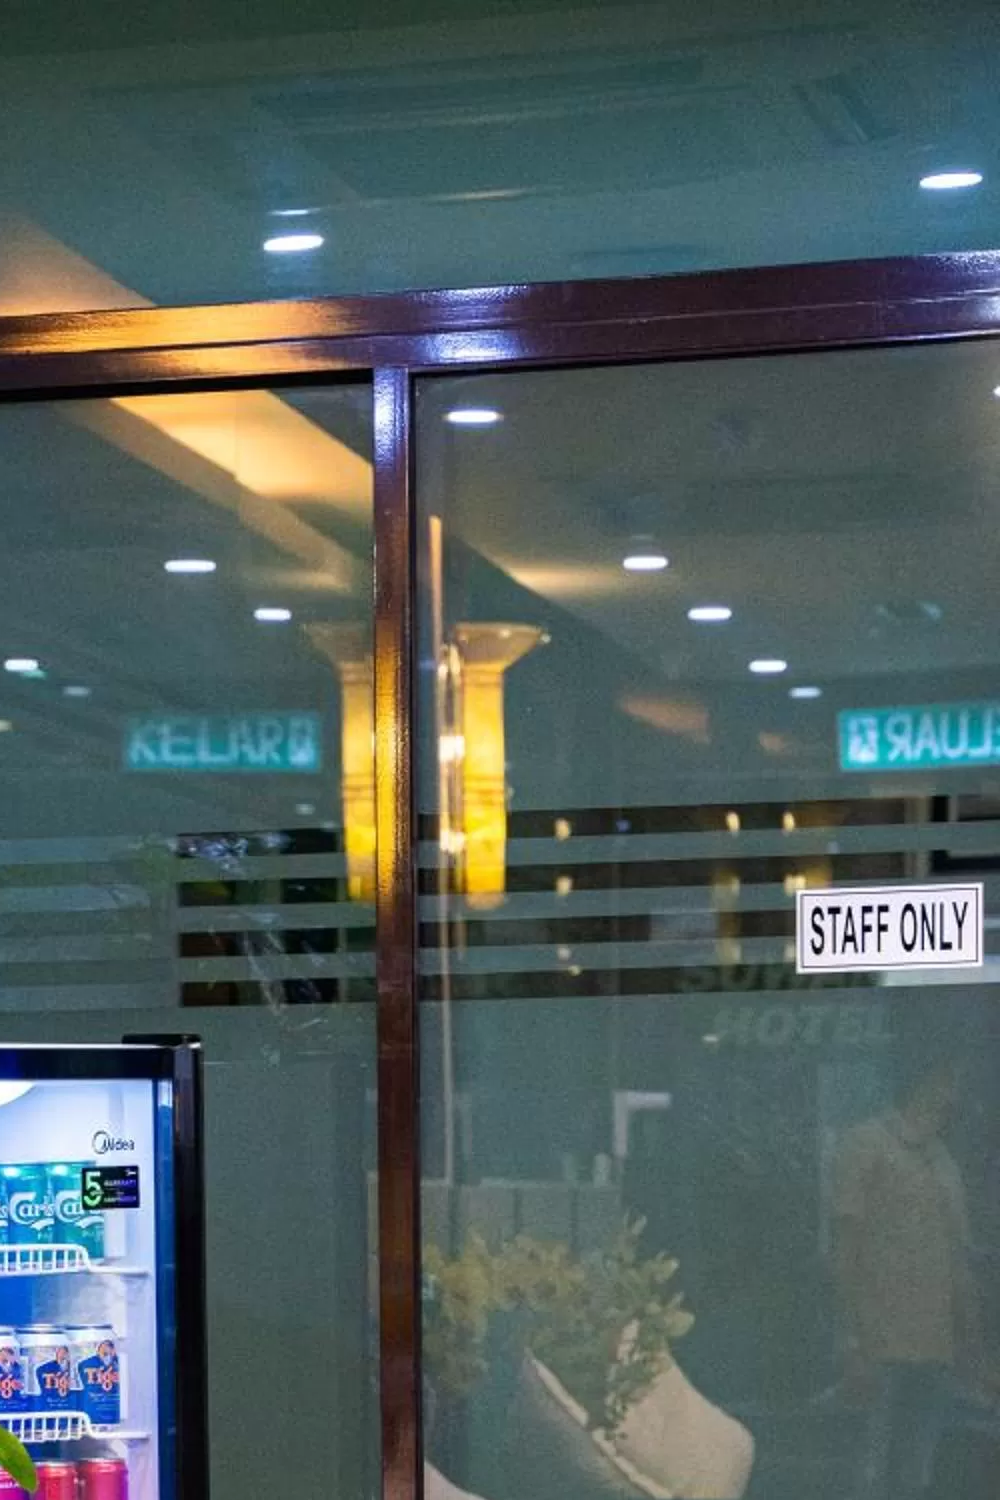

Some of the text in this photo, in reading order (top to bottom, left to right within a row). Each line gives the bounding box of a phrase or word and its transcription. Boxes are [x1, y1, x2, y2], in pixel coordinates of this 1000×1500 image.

[811, 900, 968, 956] STAFF ONLY
[83, 1171, 102, 1207] 5
